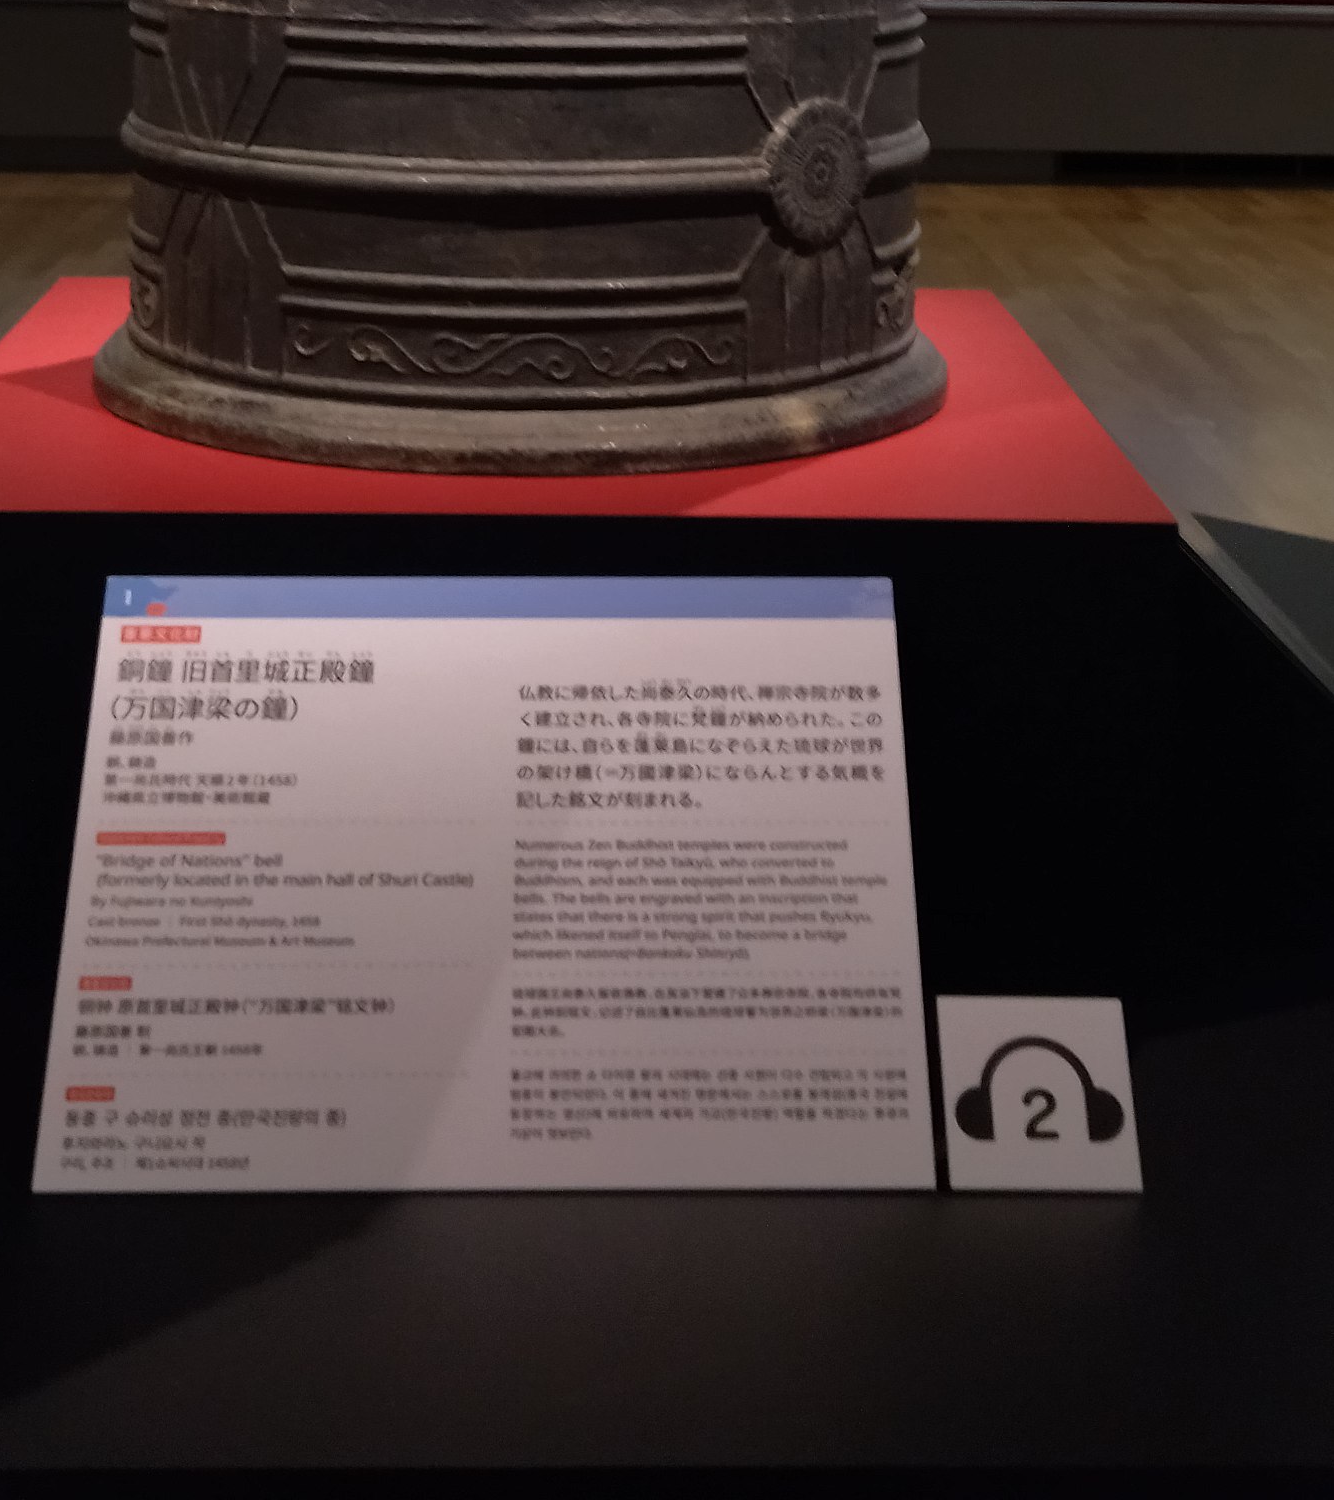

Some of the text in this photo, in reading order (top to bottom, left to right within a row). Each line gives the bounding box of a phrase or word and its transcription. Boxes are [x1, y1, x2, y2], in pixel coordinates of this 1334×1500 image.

[515, 840, 584, 851] Numerous
[588, 839, 612, 851] Zen
[615, 839, 674, 851] Buddhist
[733, 841, 767, 851] were
[769, 840, 848, 851] constructed
[159, 854, 177, 868] of
[253, 854, 283, 868] bell
[562, 857, 584, 869] the
[624, 857, 639, 868] of
[719, 857, 748, 868] who
[820, 858, 835, 868] to
[96, 871, 474, 890] (formerly located in the main hall of Shuri Castle)
[588, 874, 614, 887] and
[85, 935, 140, 947] Okinawa
[213, 936, 268, 947] Museum
[281, 936, 301, 946] Art
[301, 936, 355, 947] Museum
[1022, 1087, 1059, 1140] 2
